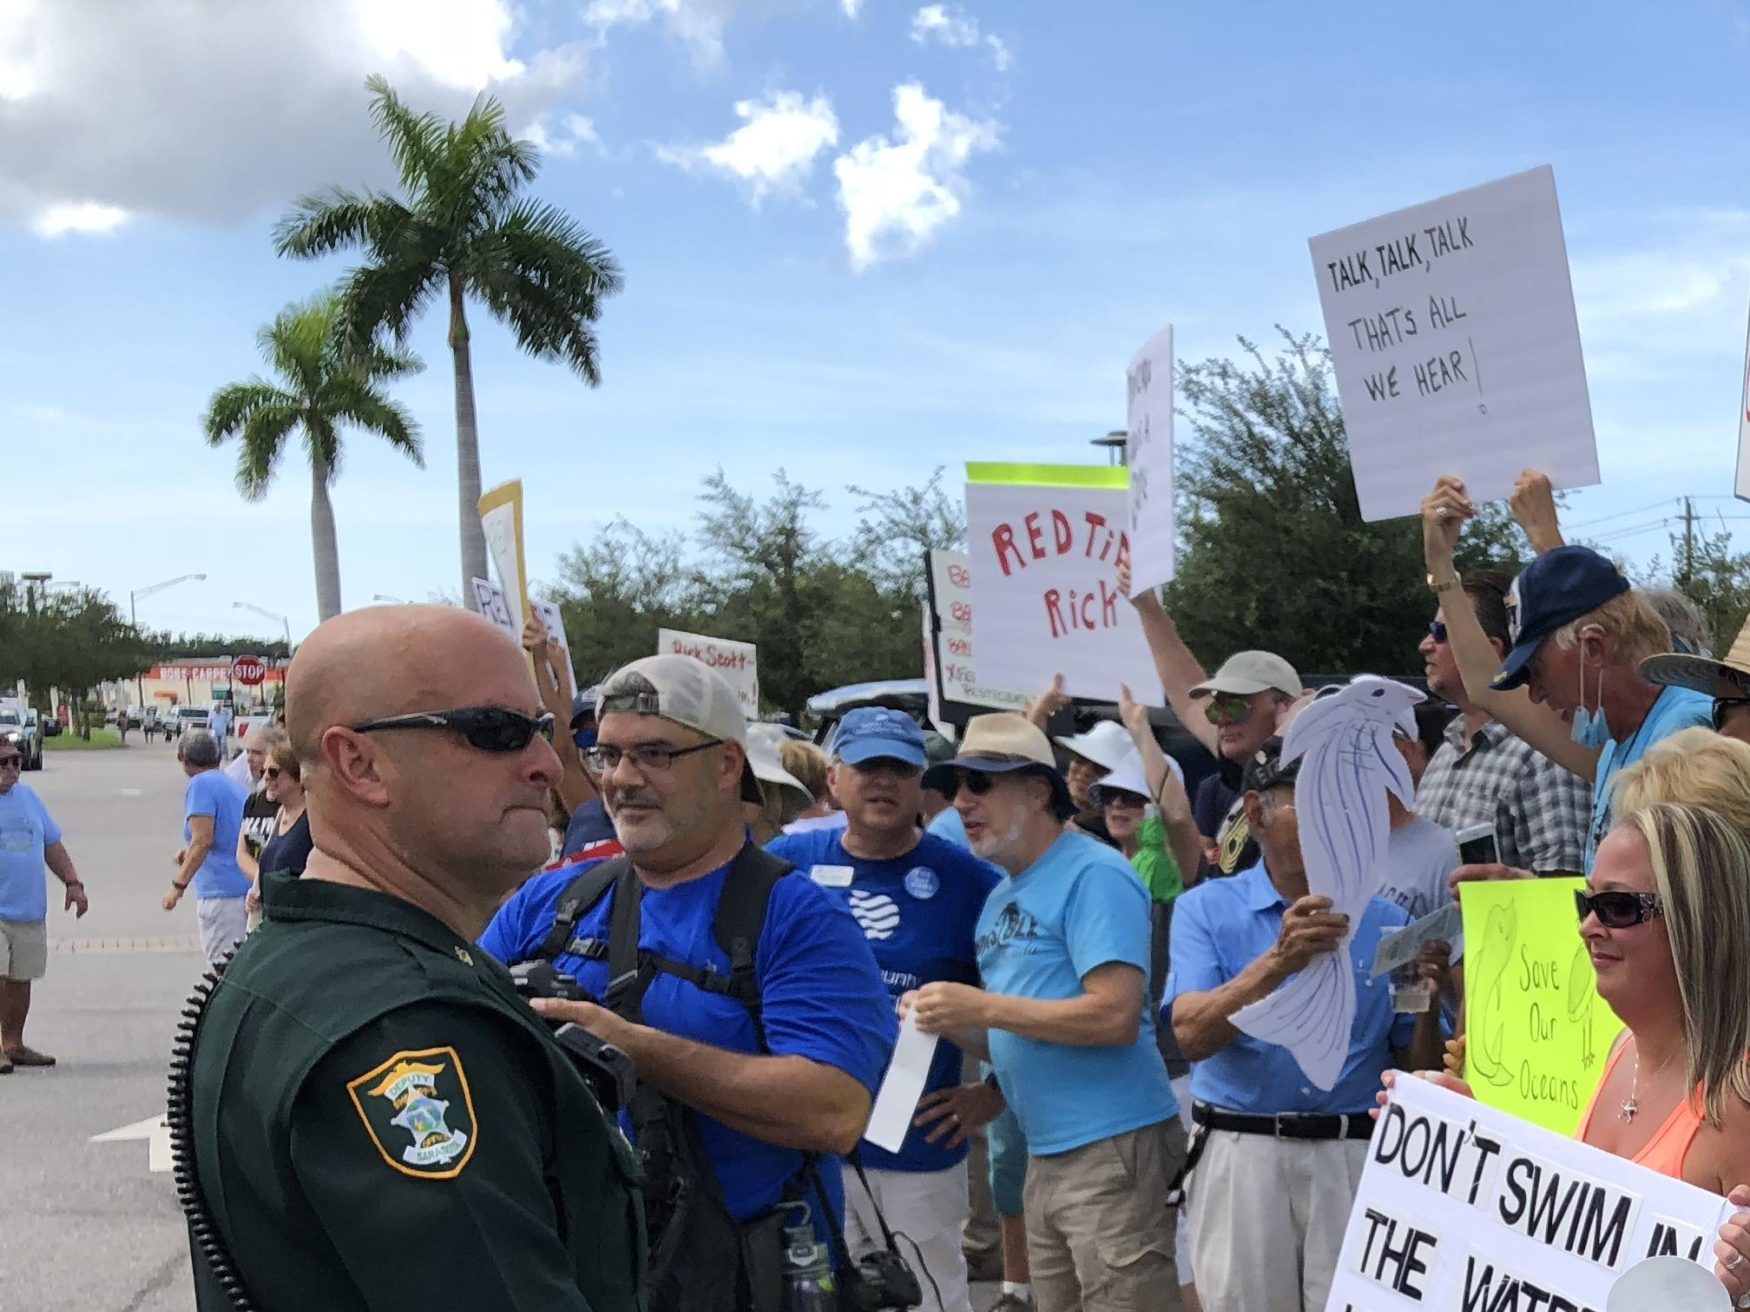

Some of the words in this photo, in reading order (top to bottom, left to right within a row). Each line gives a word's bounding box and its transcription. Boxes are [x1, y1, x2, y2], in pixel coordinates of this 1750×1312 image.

[1423, 215, 1474, 258] TALK
[1429, 295, 1467, 329] ALL
[1363, 365, 1401, 402] WE
[991, 508, 1074, 577] RED
[1044, 580, 1119, 639] Rick
[234, 664, 264, 680] STOP
[1519, 943, 1560, 992] Save
[1529, 1001, 1557, 1043] Our
[1519, 1058, 1579, 1110] Oceans
[1374, 1102, 1500, 1202] DON'T
[1498, 1156, 1632, 1268] SWIM
[1355, 1206, 1438, 1302] THE
